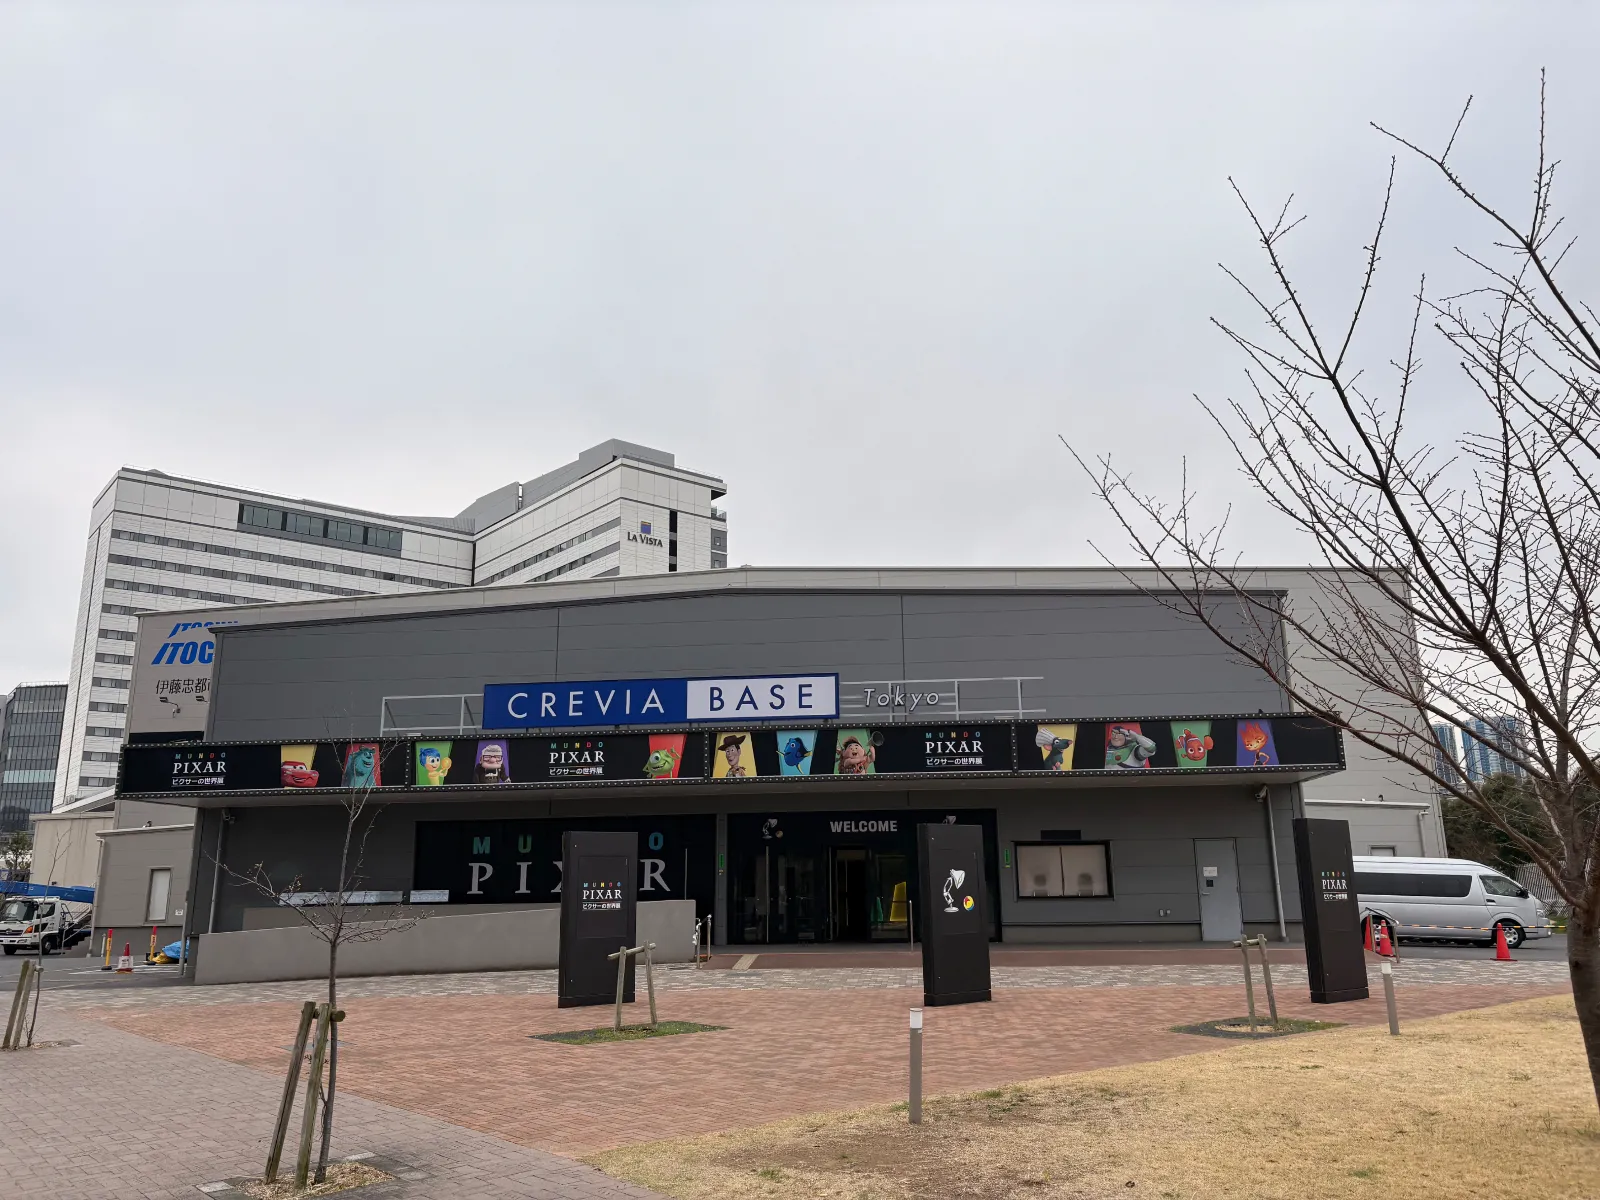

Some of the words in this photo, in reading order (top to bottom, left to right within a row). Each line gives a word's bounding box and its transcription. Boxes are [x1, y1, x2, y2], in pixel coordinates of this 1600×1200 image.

[627, 531, 638, 543] LA
[639, 534, 663, 548] VISTA
[507, 688, 665, 718] CREVIA
[709, 683, 813, 712] BASE
[864, 685, 940, 711] Tokyo
[926, 731, 981, 739] MUNDO
[550, 741, 604, 749] MUNDO
[925, 740, 984, 754] PIXAR
[175, 752, 226, 760] MUNDO
[549, 750, 605, 764] PIXAR
[172, 761, 227, 774] PIXAR
[829, 820, 898, 833] WELCOME
[472, 832, 664, 855] MUO
[466, 858, 671, 895] PIR
[1322, 880, 1348, 890] PIXAR
[582, 889, 622, 900] PIXAR
